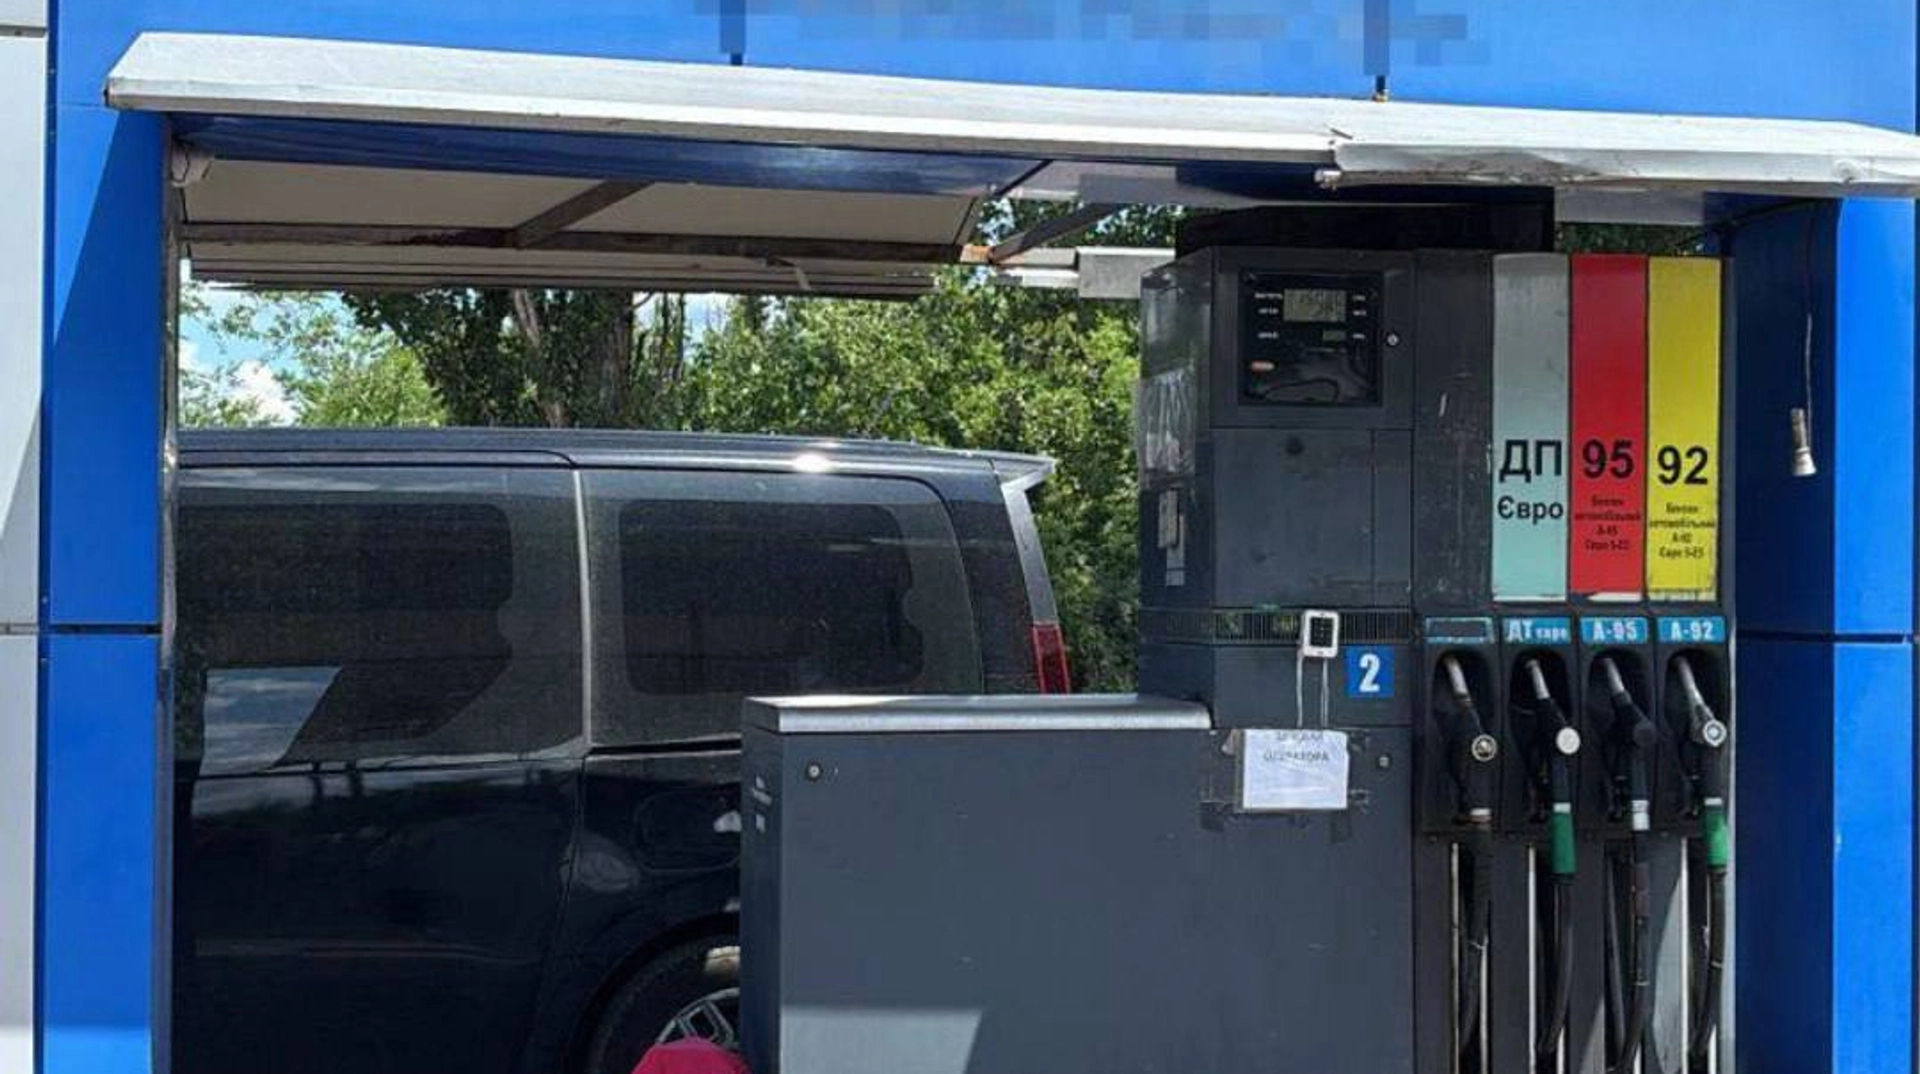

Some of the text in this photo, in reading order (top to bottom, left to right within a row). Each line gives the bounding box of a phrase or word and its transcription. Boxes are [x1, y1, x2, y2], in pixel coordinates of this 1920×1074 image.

[1499, 439, 1562, 484] ДП
[1582, 438, 1634, 479] 95
[1657, 445, 1708, 485] 92
[1497, 494, 1564, 525] Євро
[1506, 618, 1533, 643] ДТ
[1593, 620, 1638, 640] А-95
[1671, 620, 1714, 640] А-92
[1359, 653, 1381, 693] 2
